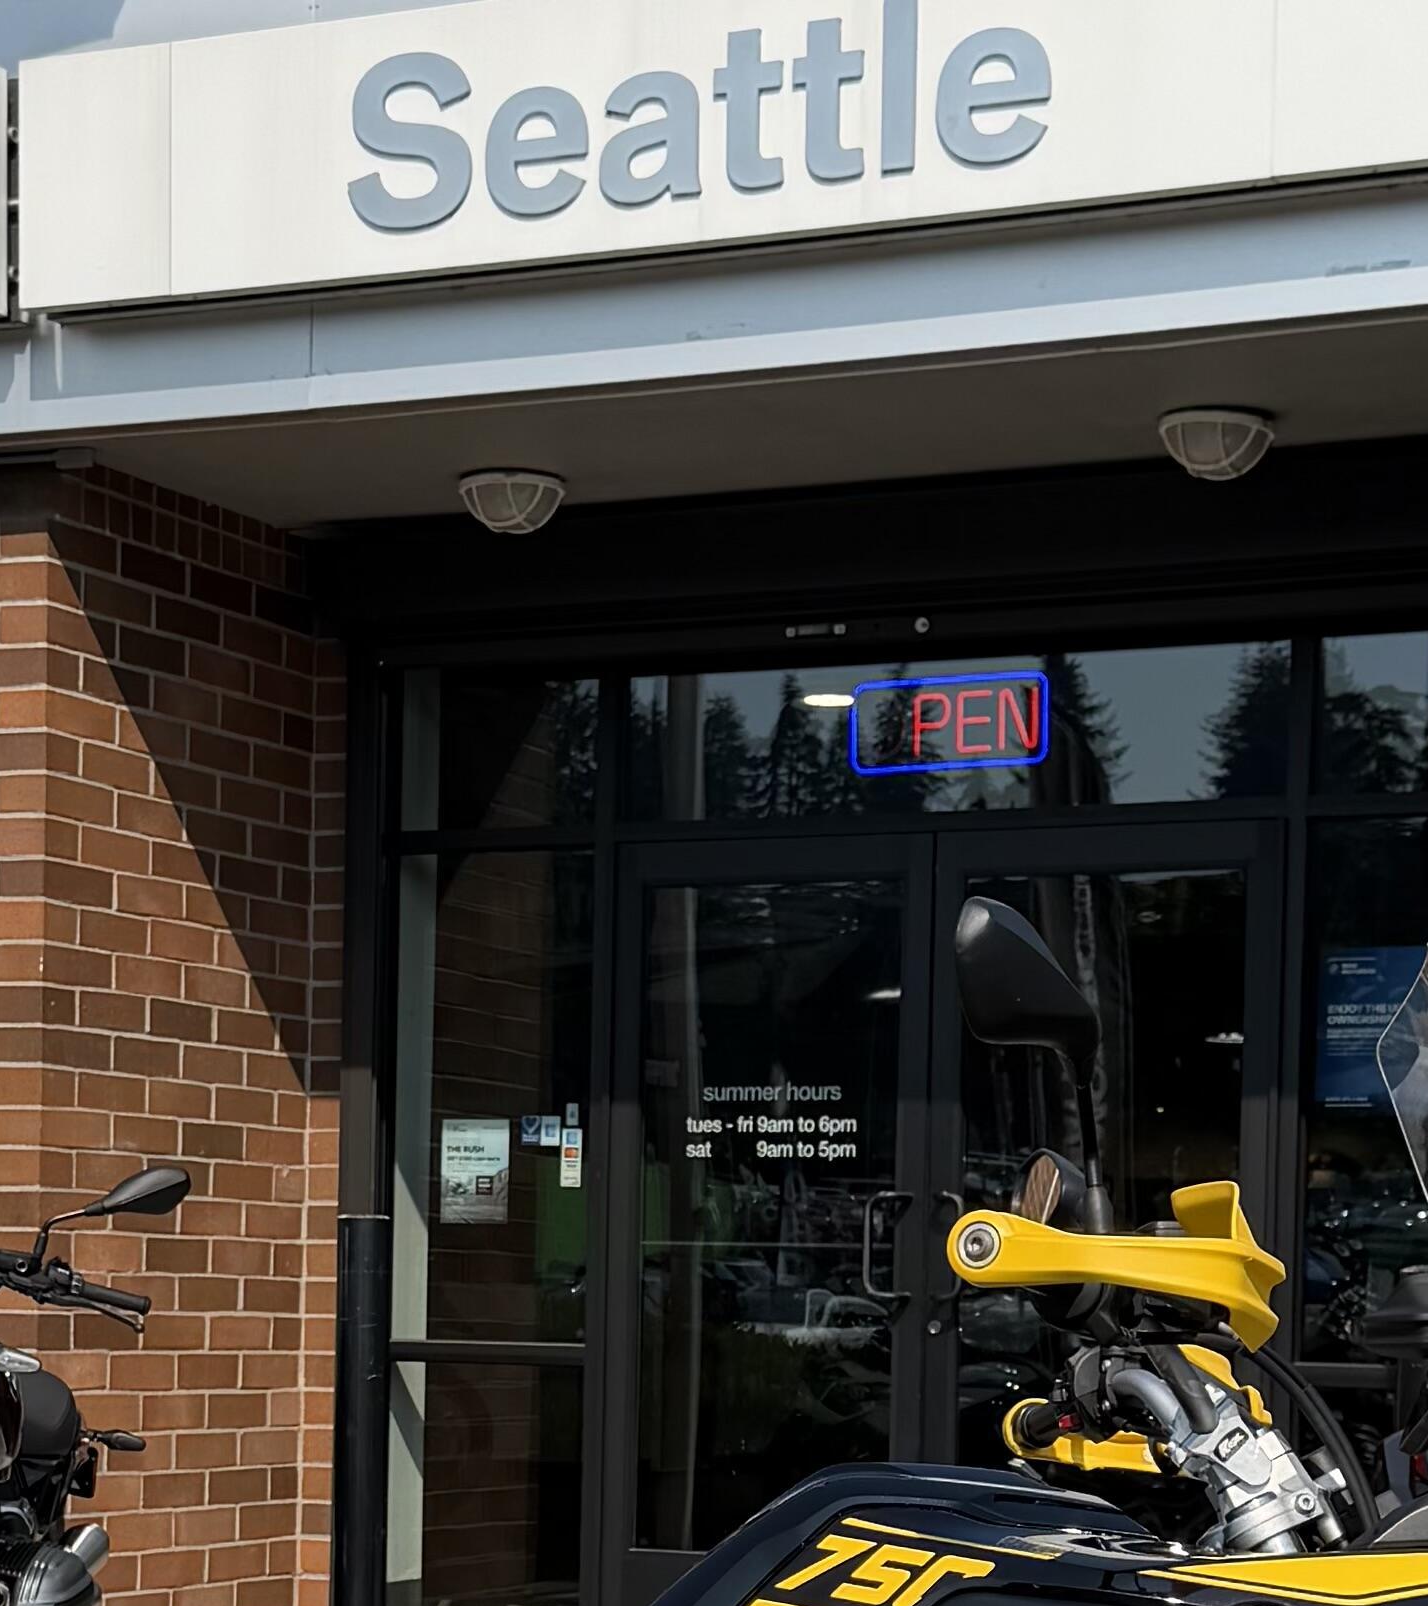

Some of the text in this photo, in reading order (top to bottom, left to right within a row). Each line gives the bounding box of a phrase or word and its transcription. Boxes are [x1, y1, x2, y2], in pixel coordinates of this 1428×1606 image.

[347, 0, 1053, 231] Seattle
[911, 687, 1040, 757] PEN
[703, 1080, 842, 1101] summer hours
[685, 1116, 722, 1133] tues
[737, 1115, 753, 1133] fri
[756, 1115, 794, 1133] 9am
[798, 1116, 815, 1133] to
[818, 1115, 858, 1137] 6pm
[685, 1140, 857, 1161] sat 9am to 5pm
